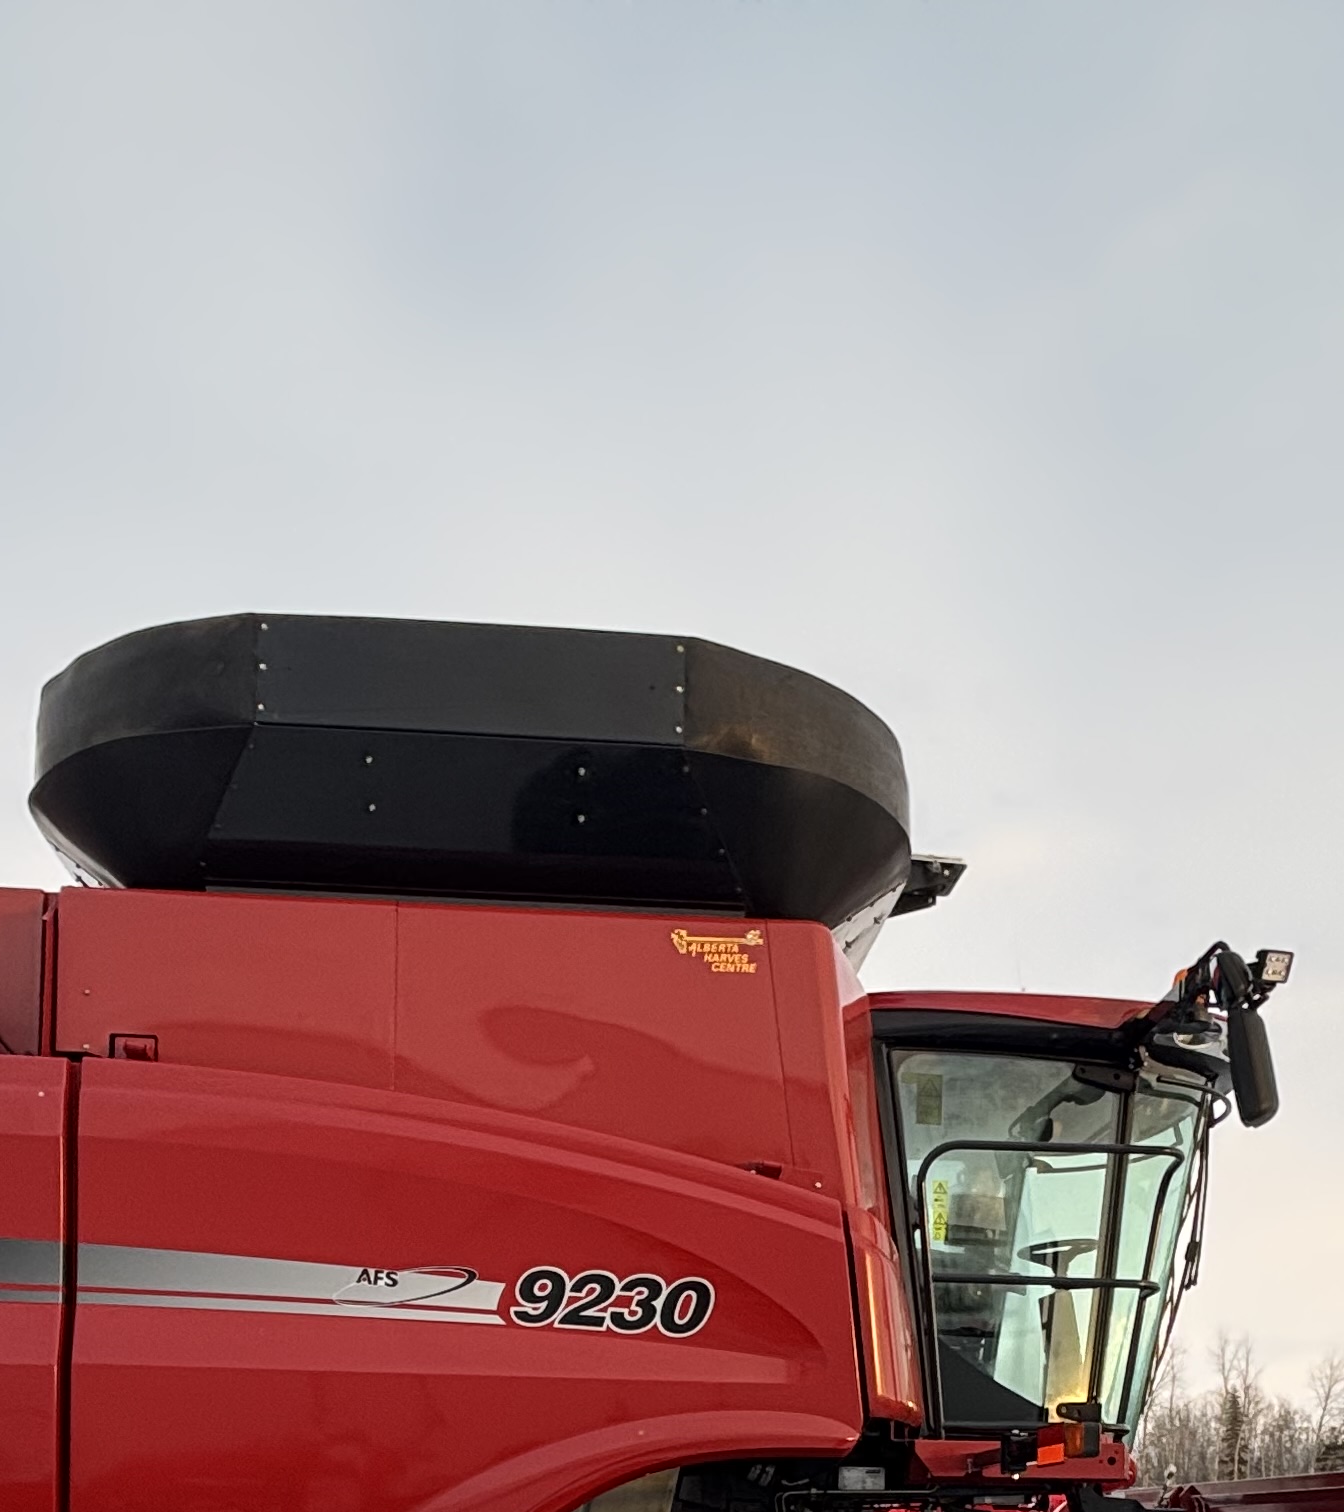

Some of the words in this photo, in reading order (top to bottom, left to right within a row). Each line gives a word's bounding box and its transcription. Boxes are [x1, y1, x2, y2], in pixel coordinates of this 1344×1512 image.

[688, 942, 739, 957] ALBERTA
[711, 962, 757, 973] CENTRE
[356, 1268, 399, 1288] AFS
[509, 1265, 716, 1338] 9230
